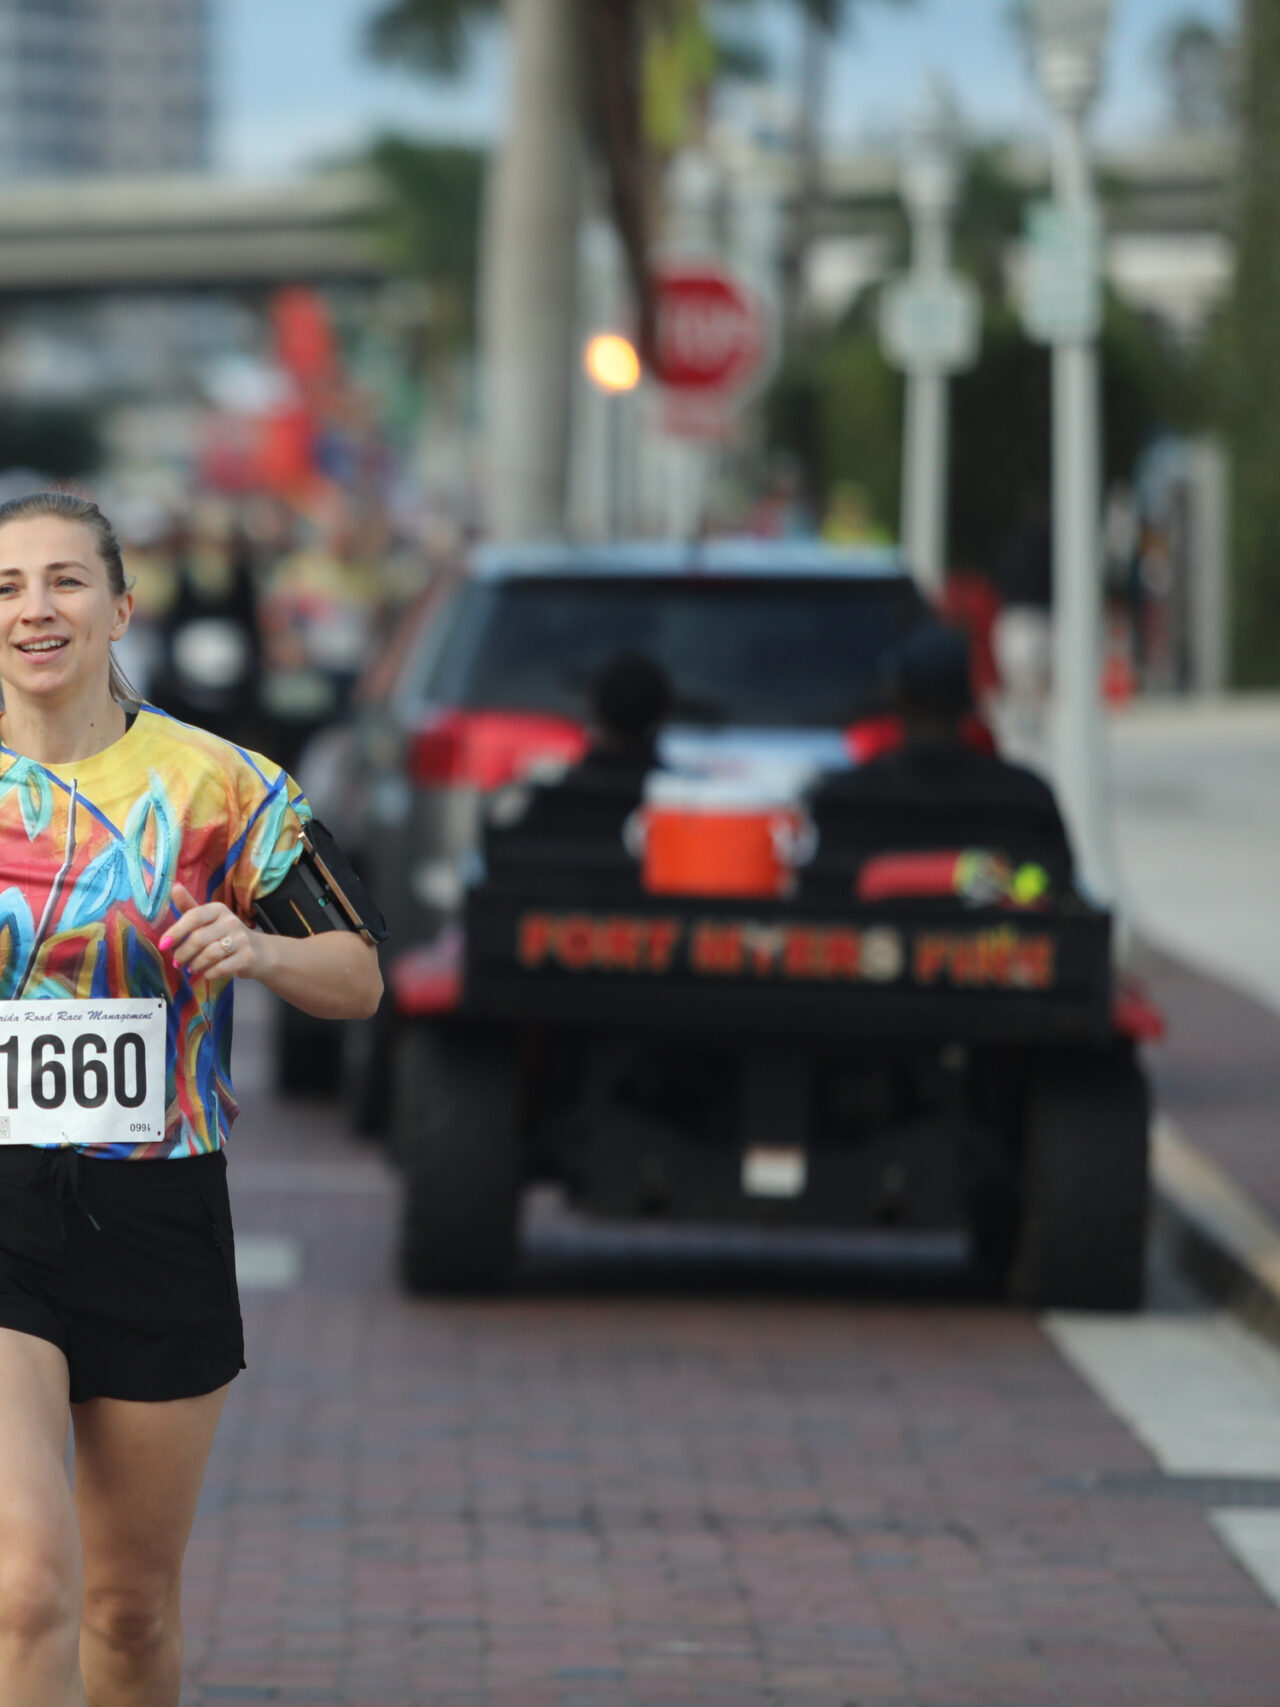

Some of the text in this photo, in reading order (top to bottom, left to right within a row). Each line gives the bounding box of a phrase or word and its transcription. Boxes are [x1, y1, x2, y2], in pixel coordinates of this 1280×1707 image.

[520, 912, 679, 971] FORT
[693, 918, 903, 982] MYERS
[24, 1012, 52, 1022] Road
[56, 1011, 84, 1021] Race
[87, 1010, 153, 1022] Management
